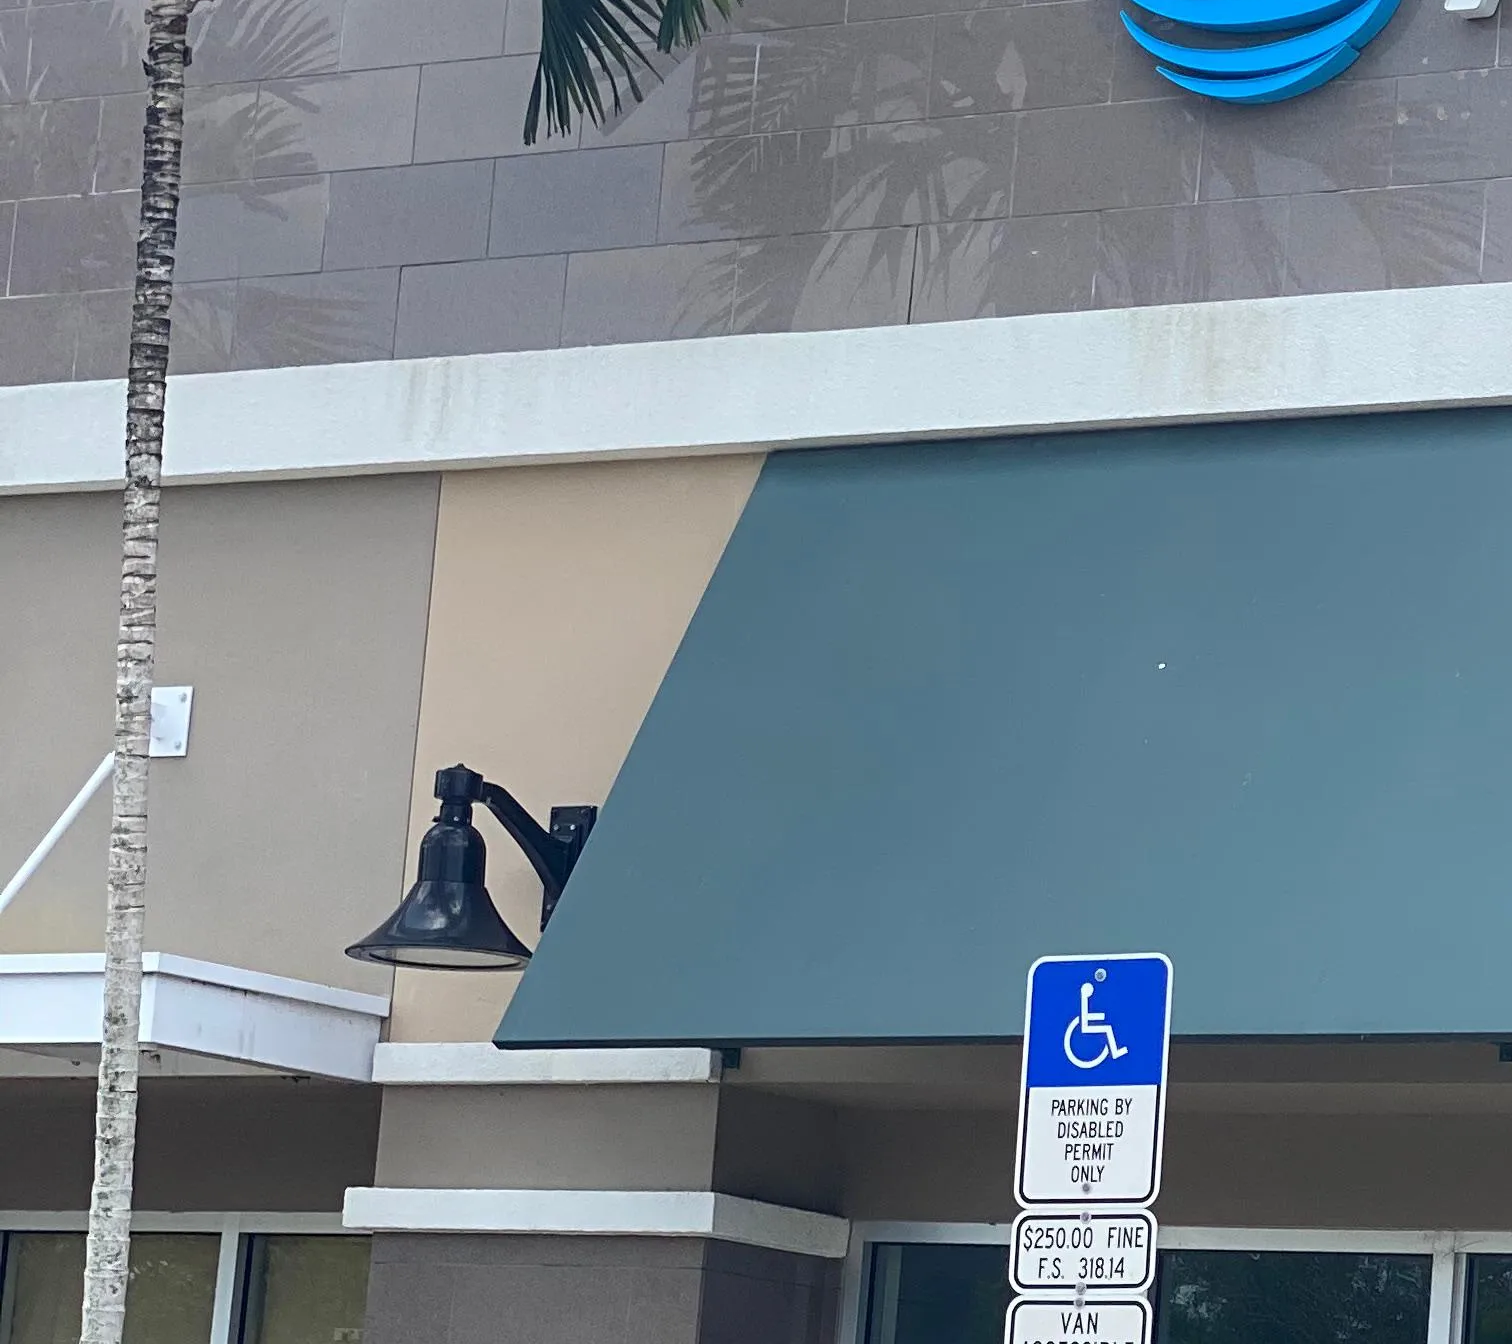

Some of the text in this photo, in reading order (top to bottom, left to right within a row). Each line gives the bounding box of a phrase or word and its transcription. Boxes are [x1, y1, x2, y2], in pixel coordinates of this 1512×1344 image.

[1051, 1098, 1133, 1116] PARKING BY
[1057, 1121, 1124, 1138] DISABLED
[1064, 1143, 1114, 1161] PERMIT
[1071, 1165, 1105, 1183] ONLY
[1023, 1225, 1144, 1252] $250.00 FINE
[1038, 1257, 1125, 1279] F.S. 318.14
[1061, 1312, 1099, 1335] VAN
